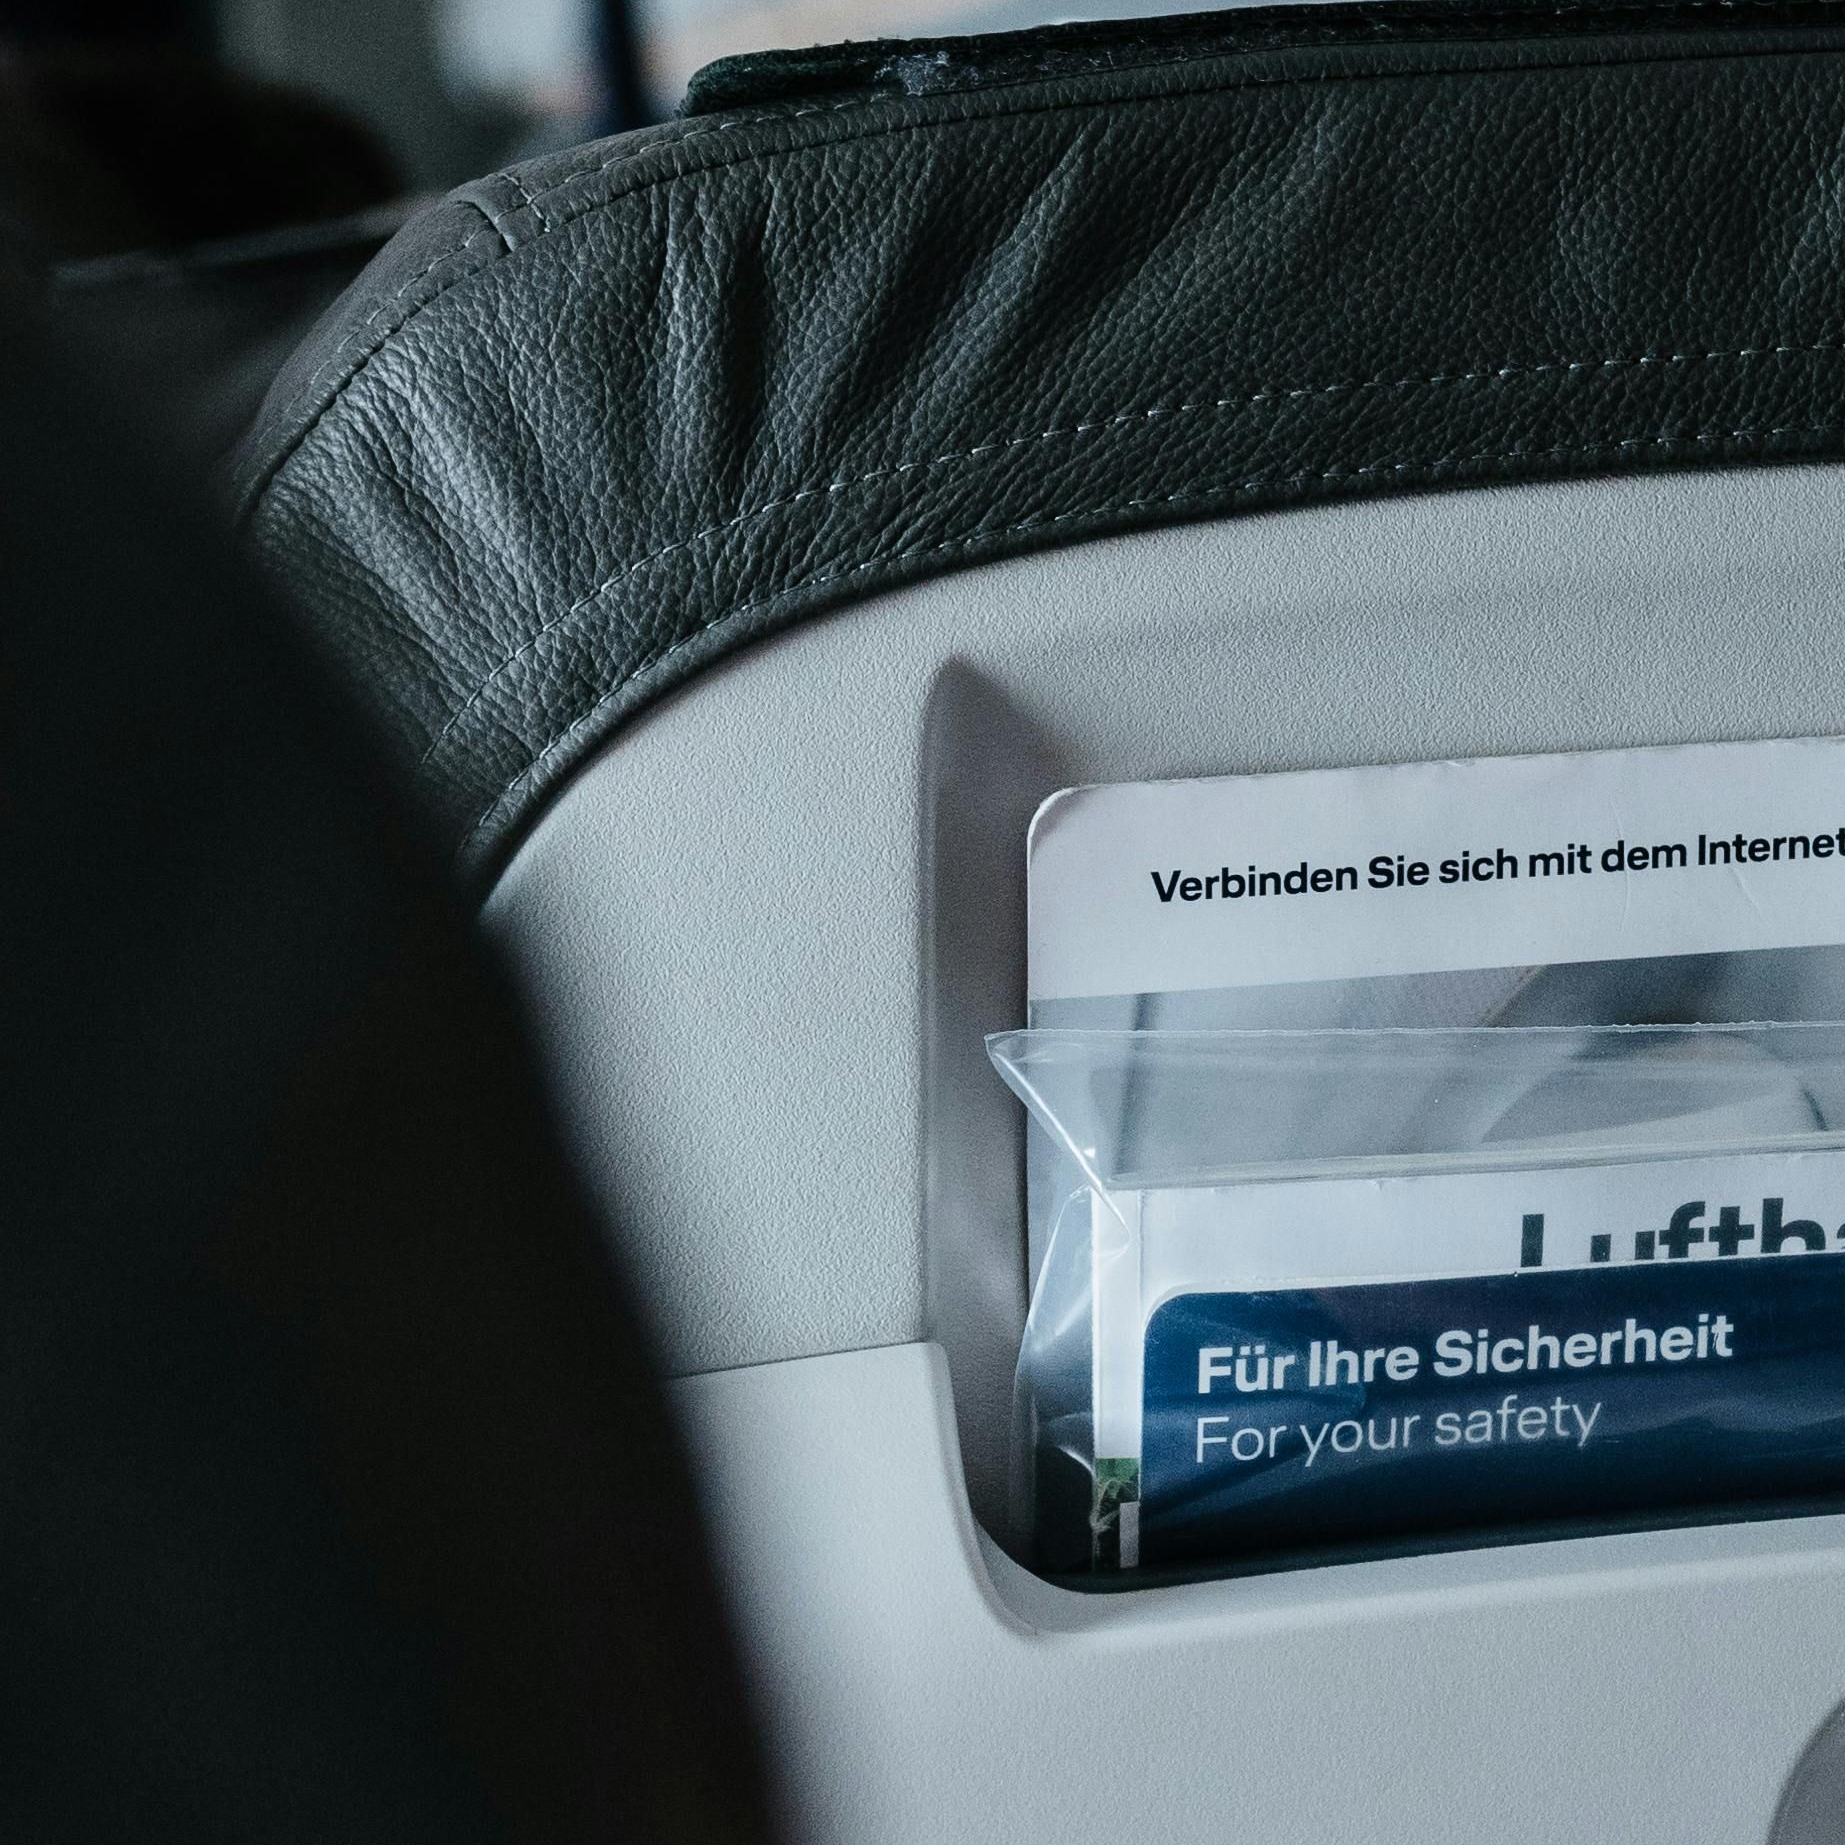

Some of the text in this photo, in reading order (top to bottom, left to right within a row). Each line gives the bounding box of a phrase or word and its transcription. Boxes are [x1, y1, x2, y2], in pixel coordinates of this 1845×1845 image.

[1150, 862, 1358, 903] Verbinden
[1367, 854, 1430, 888] Sie
[1438, 847, 1518, 882] sich
[1529, 843, 1592, 877] mit
[1600, 839, 1688, 872] dem
[1198, 1313, 1735, 1394] Für Ihre Sicherheit
[1195, 1393, 1602, 1468] For your safety
